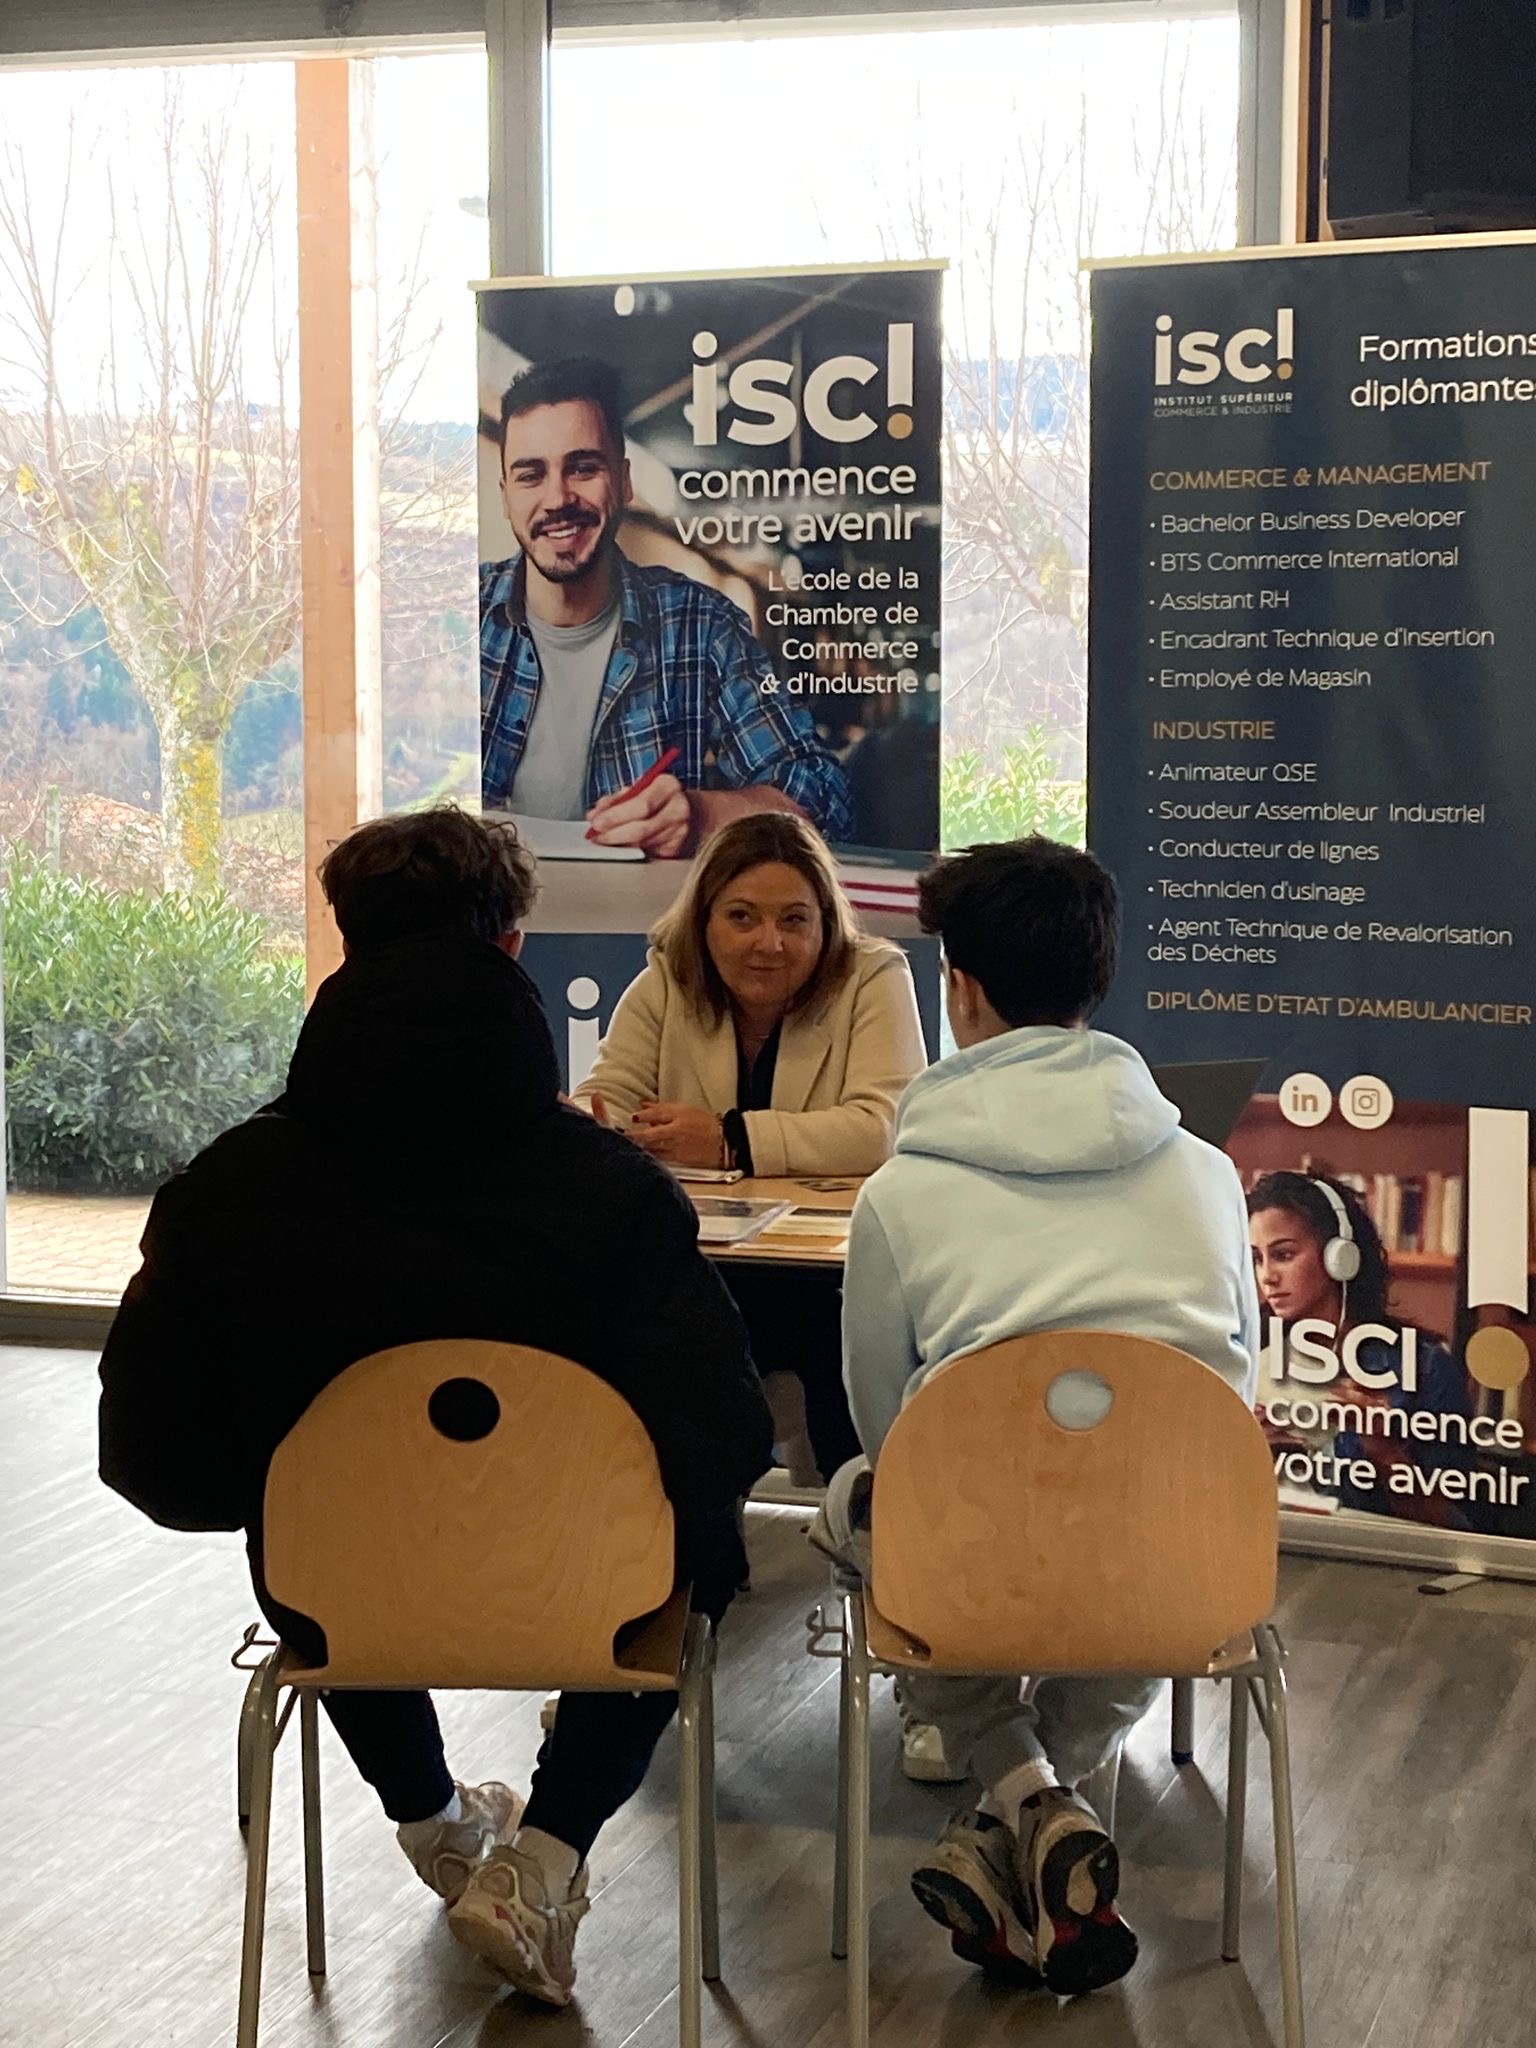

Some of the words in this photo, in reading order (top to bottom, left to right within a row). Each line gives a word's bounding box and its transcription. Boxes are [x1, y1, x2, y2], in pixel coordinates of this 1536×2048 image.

[1154, 396, 1213, 406] INSTITUT
[1220, 392, 1293, 404] SUPÉRIEUR
[1350, 376, 1536, 412] diplômante
[1154, 406, 1218, 417] COMMERCE
[1222, 406, 1229, 415] &
[1232, 404, 1292, 414] INDUSTRIE
[679, 464, 916, 499] commence
[1150, 469, 1287, 492] COMMERCE
[1294, 468, 1311, 487] &
[1317, 461, 1492, 487] MANAGEMENT
[674, 512, 782, 545] votre
[794, 504, 922, 543] avenir
[1161, 513, 1255, 533] Bachelor
[1260, 511, 1350, 531] Business
[1356, 508, 1465, 531] Developer
[1161, 553, 1201, 572] BTS
[1207, 551, 1322, 571] Commerce
[1328, 548, 1458, 568] International
[858, 568, 891, 590] de
[899, 567, 919, 589] la
[1160, 592, 1254, 610] Assistant
[1260, 590, 1290, 608] RH
[765, 603, 877, 626] Chambre
[885, 602, 918, 624] de
[782, 638, 919, 660] Commerce
[1160, 630, 1268, 649] Encadrant
[1272, 628, 1378, 650] Technique
[760, 674, 780, 694] &
[787, 672, 919, 694] d'Industrie
[1160, 669, 1251, 690] Employé
[1257, 669, 1284, 686] de
[1289, 668, 1371, 690] Magasin
[1153, 721, 1275, 740] INDUSTRIE
[1158, 763, 1268, 782] Animateur
[1273, 763, 1317, 782] QSE
[1159, 801, 1251, 820] Soudeur
[1255, 802, 1378, 822] Assembleur
[1389, 803, 1485, 823] Industriel
[1159, 839, 1282, 858] Conducteur
[1288, 840, 1315, 859] de
[1158, 880, 1265, 899] Technicien
[1271, 880, 1365, 905] d'usinage
[1159, 918, 1221, 940] Agent
[1226, 917, 1328, 943] Technique
[1334, 921, 1362, 941] de
[1368, 923, 1512, 946] Revalorisation
[1148, 943, 1186, 962] des
[1192, 944, 1277, 964] Déchets
[1147, 989, 1251, 1012] DIPLÔME
[1256, 994, 1332, 1016] D'ETAT
[1338, 998, 1532, 1024] D'AMBULANCIER
[1266, 1397, 1524, 1449] commence
[1389, 1464, 1530, 1506] avenir
